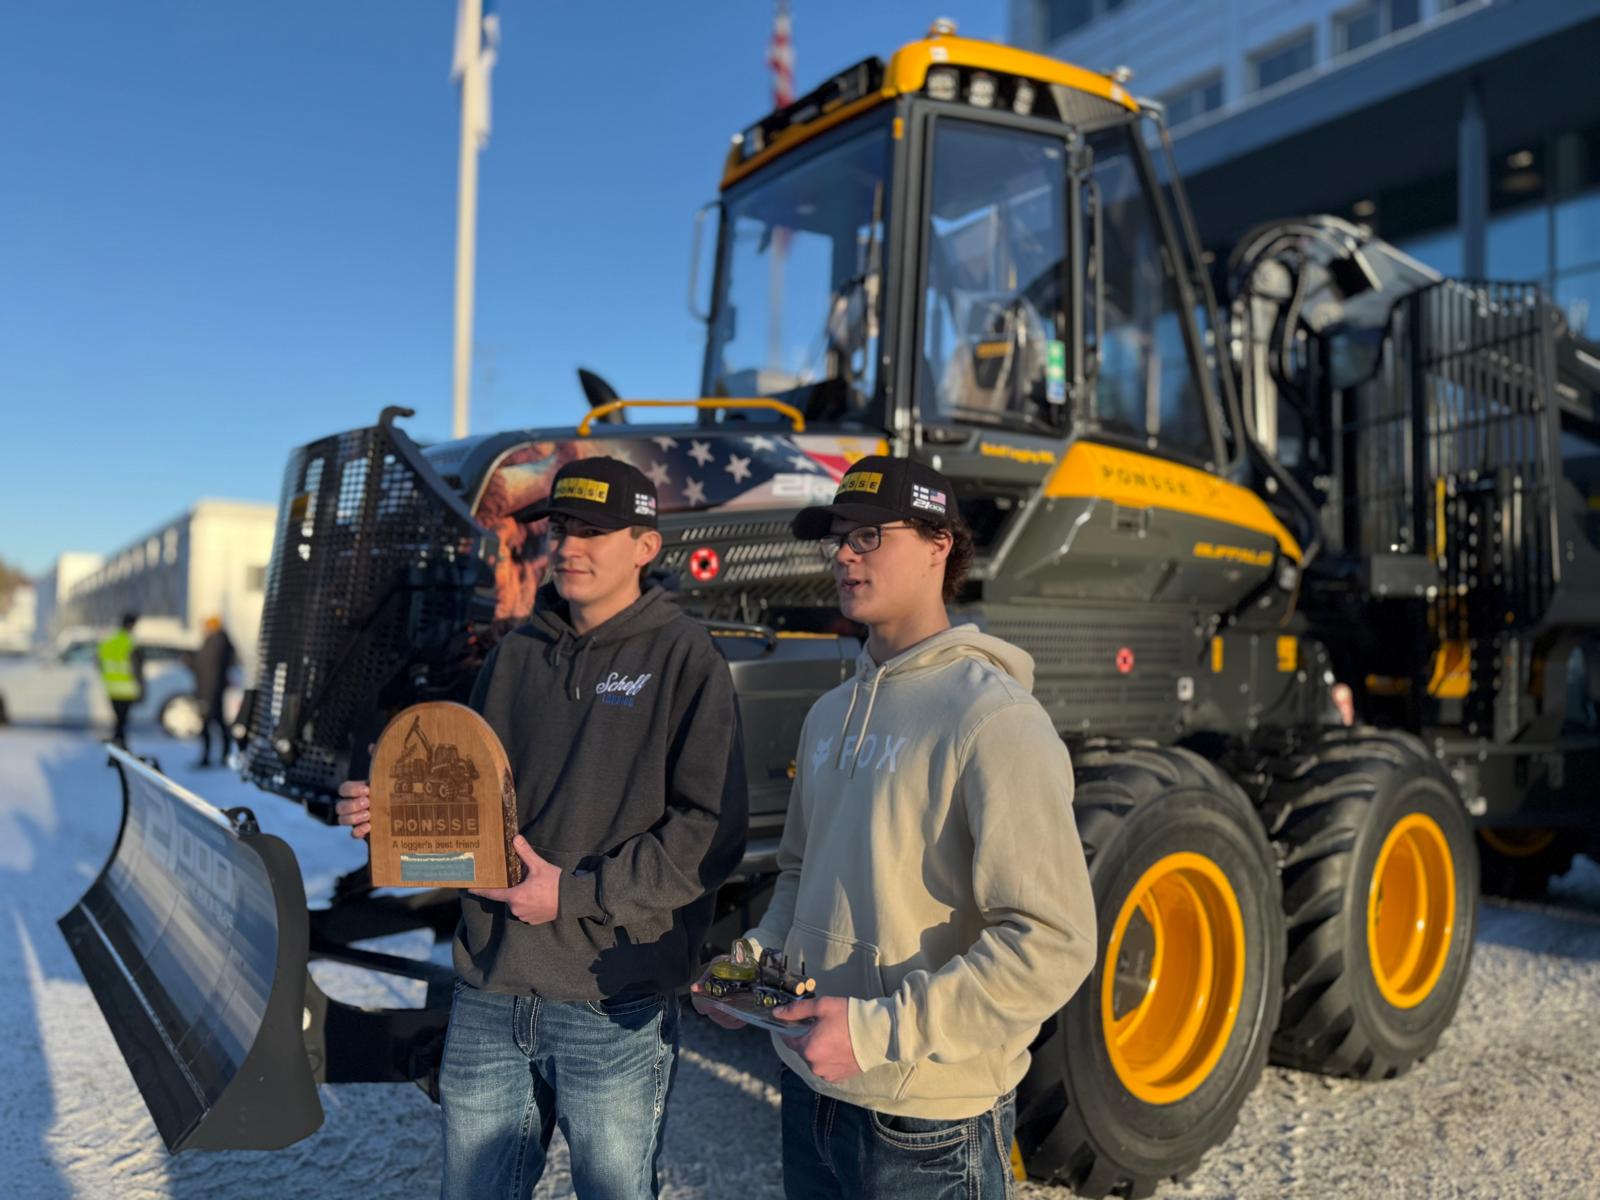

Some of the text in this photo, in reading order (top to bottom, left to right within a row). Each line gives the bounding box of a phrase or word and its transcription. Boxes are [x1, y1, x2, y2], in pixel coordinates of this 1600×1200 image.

[838, 734, 907, 773] FOX
[393, 818, 477, 832] PONSSE
[392, 840, 399, 849] A
